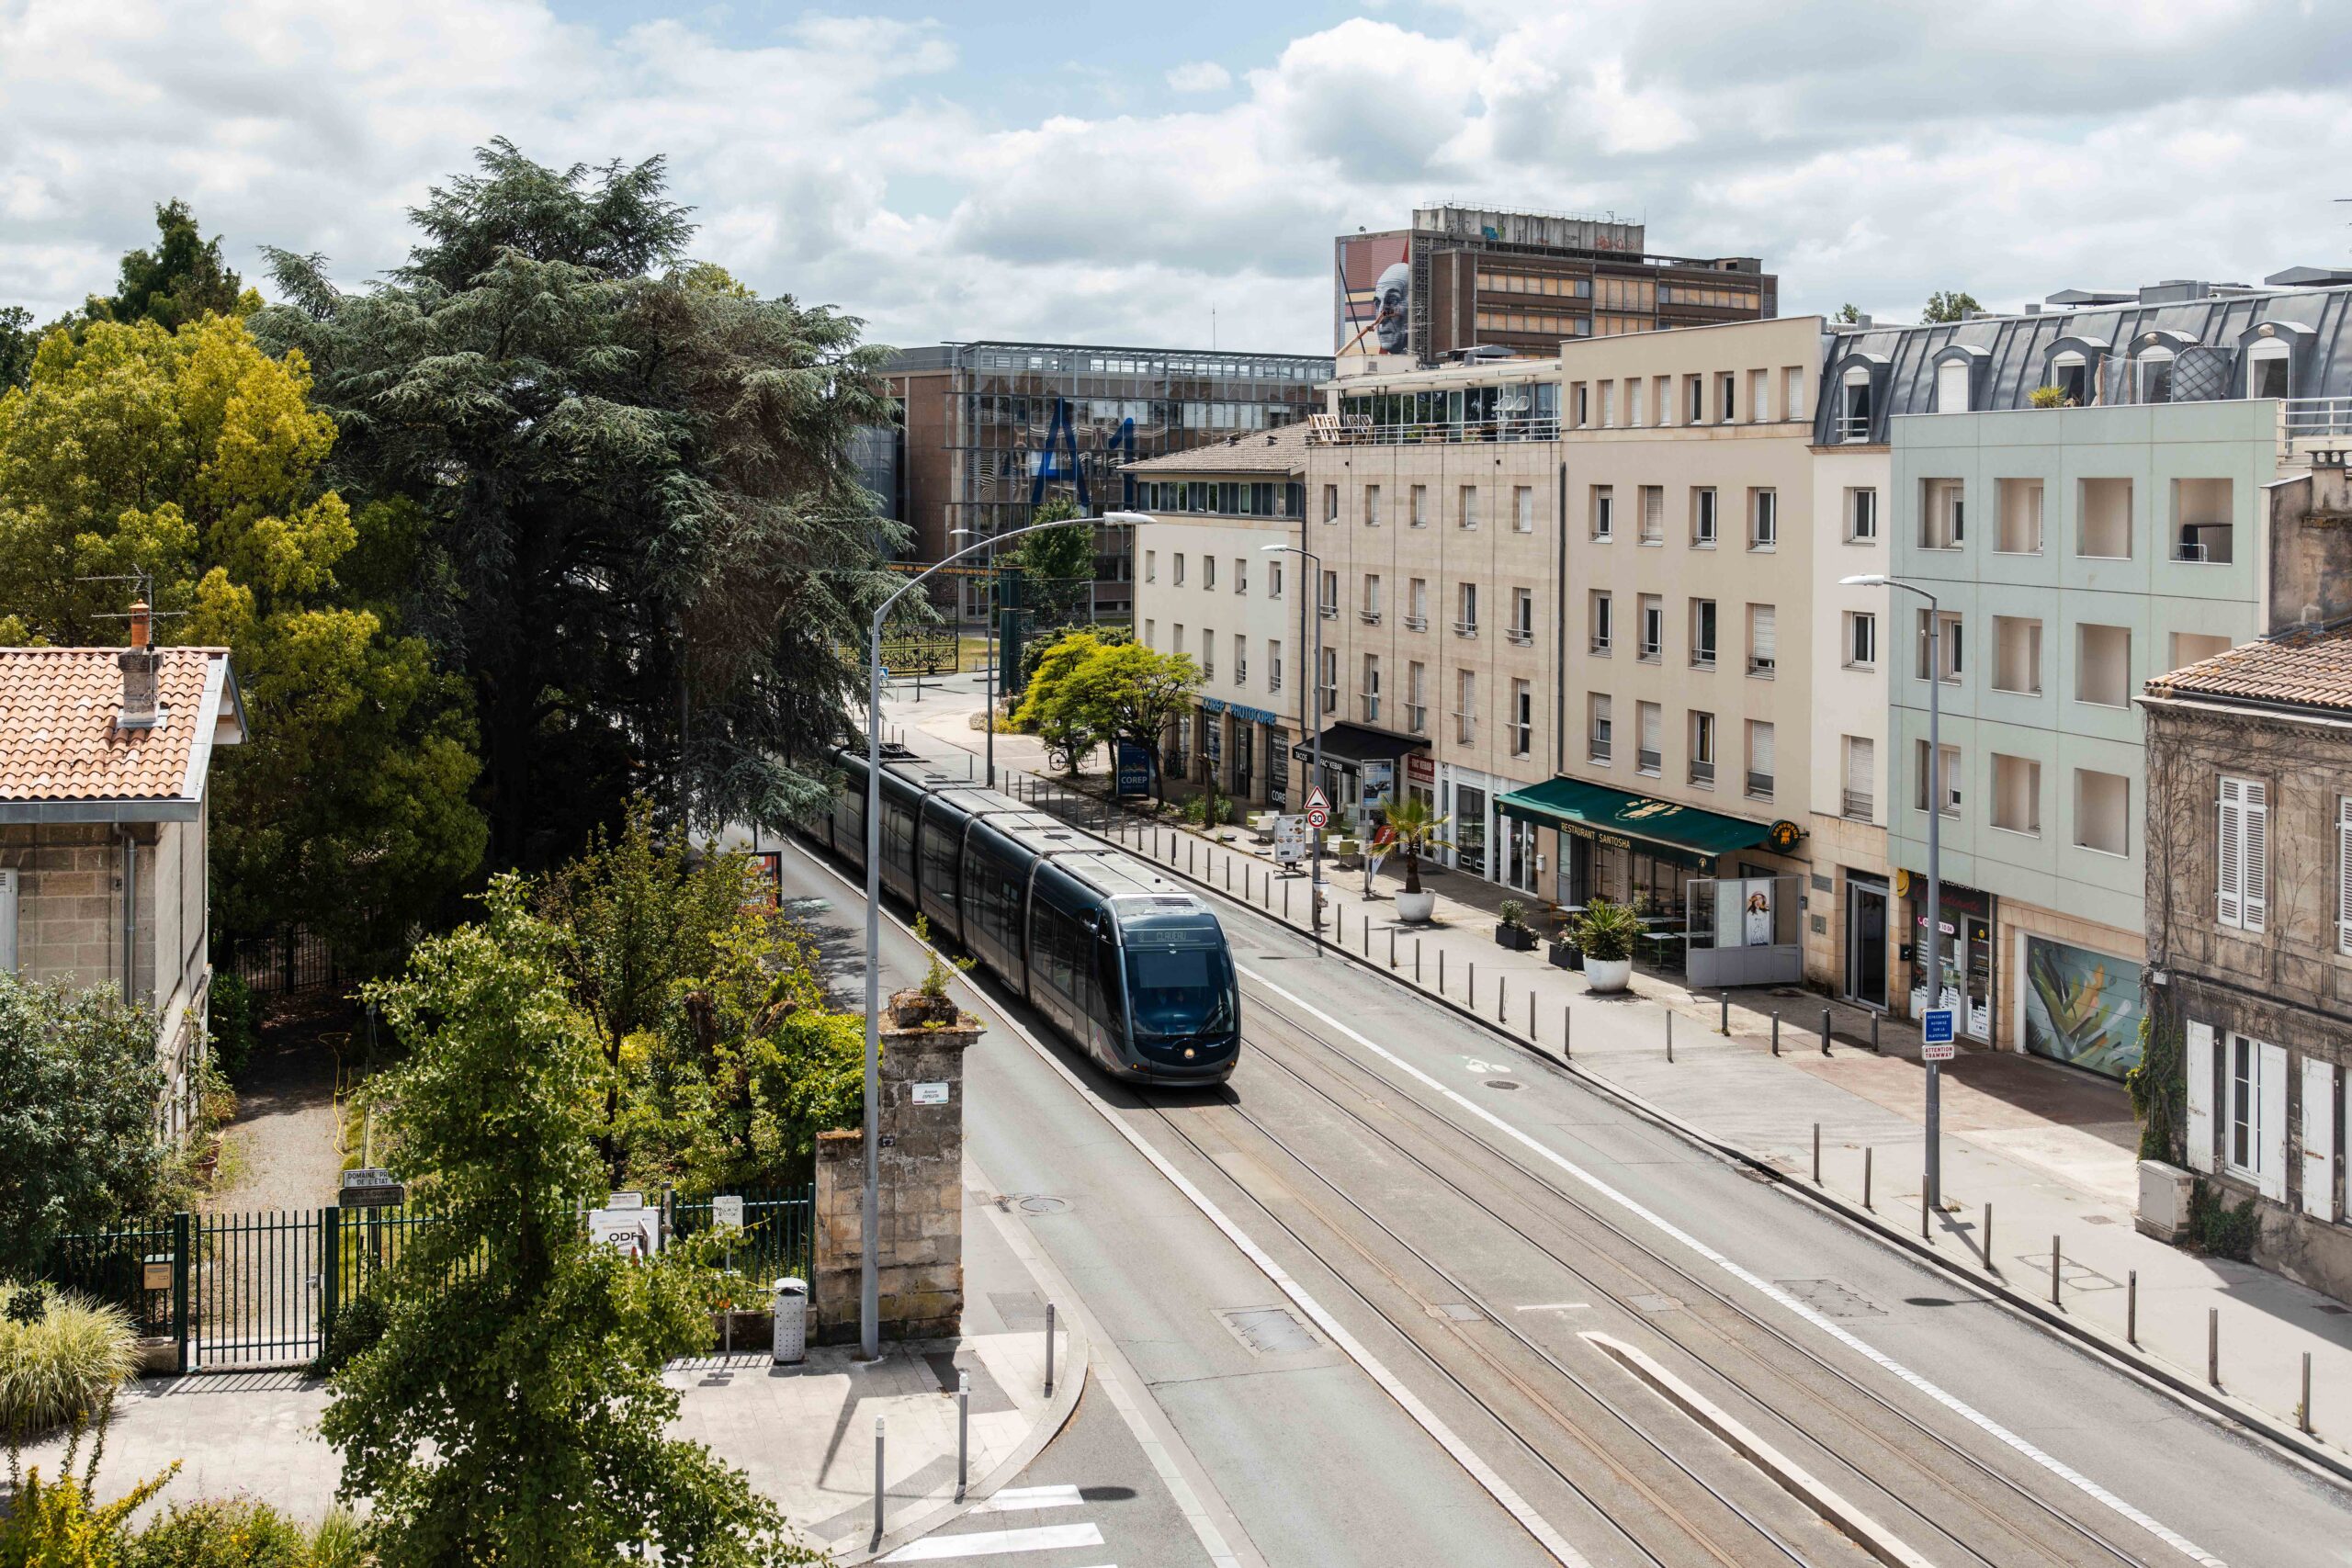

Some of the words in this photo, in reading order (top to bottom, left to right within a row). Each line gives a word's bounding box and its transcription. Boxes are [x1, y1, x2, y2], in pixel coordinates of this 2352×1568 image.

[1203, 695, 1226, 712] COREP
[1229, 702, 1277, 725] PHOTOCOPIE
[1295, 751, 1307, 761] TACOS
[1329, 761, 1342, 772] KEBAB
[1121, 776, 1148, 784] COREP
[1271, 790, 1286, 805] CORE
[1312, 815, 1323, 823] 30
[1561, 822, 1595, 840] RESTAURANT
[1599, 833, 1631, 849] SANTOSHA
[1156, 931, 1187, 941] CLAVEAU
[347, 1171, 376, 1179] DOMAINE
